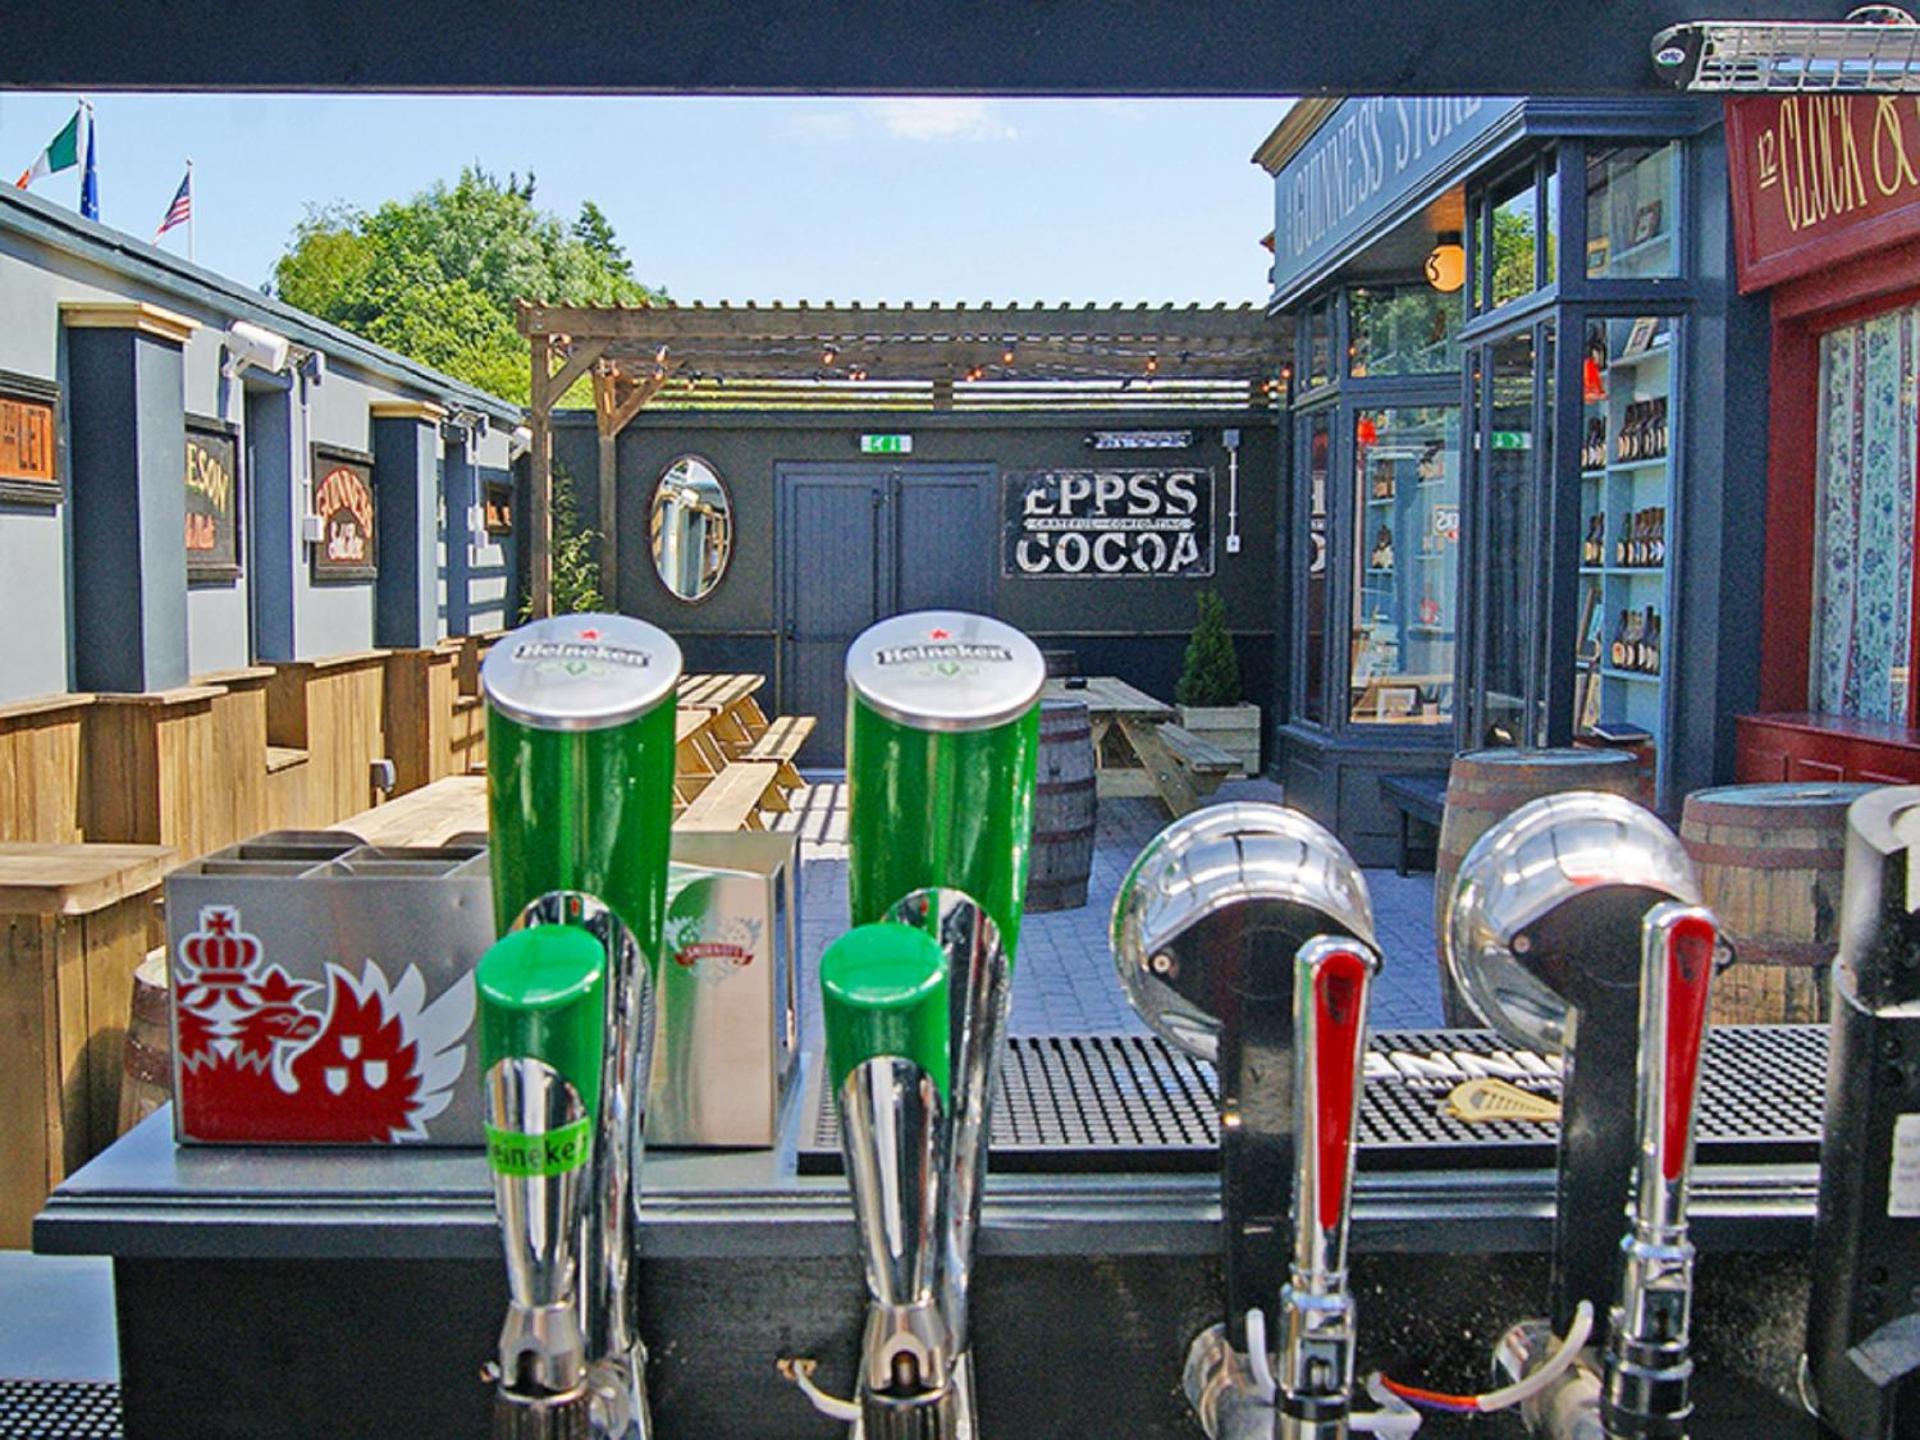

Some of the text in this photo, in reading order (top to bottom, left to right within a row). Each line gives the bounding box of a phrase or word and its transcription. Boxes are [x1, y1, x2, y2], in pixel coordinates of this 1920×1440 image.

[1293, 97, 1386, 256] GUINNESS
[1780, 97, 1868, 232] CLOCK
[186, 442, 229, 513] ESON
[1016, 531, 1199, 573] COCOA
[516, 644, 648, 668] Heineken
[882, 643, 1006, 665] Heineken
